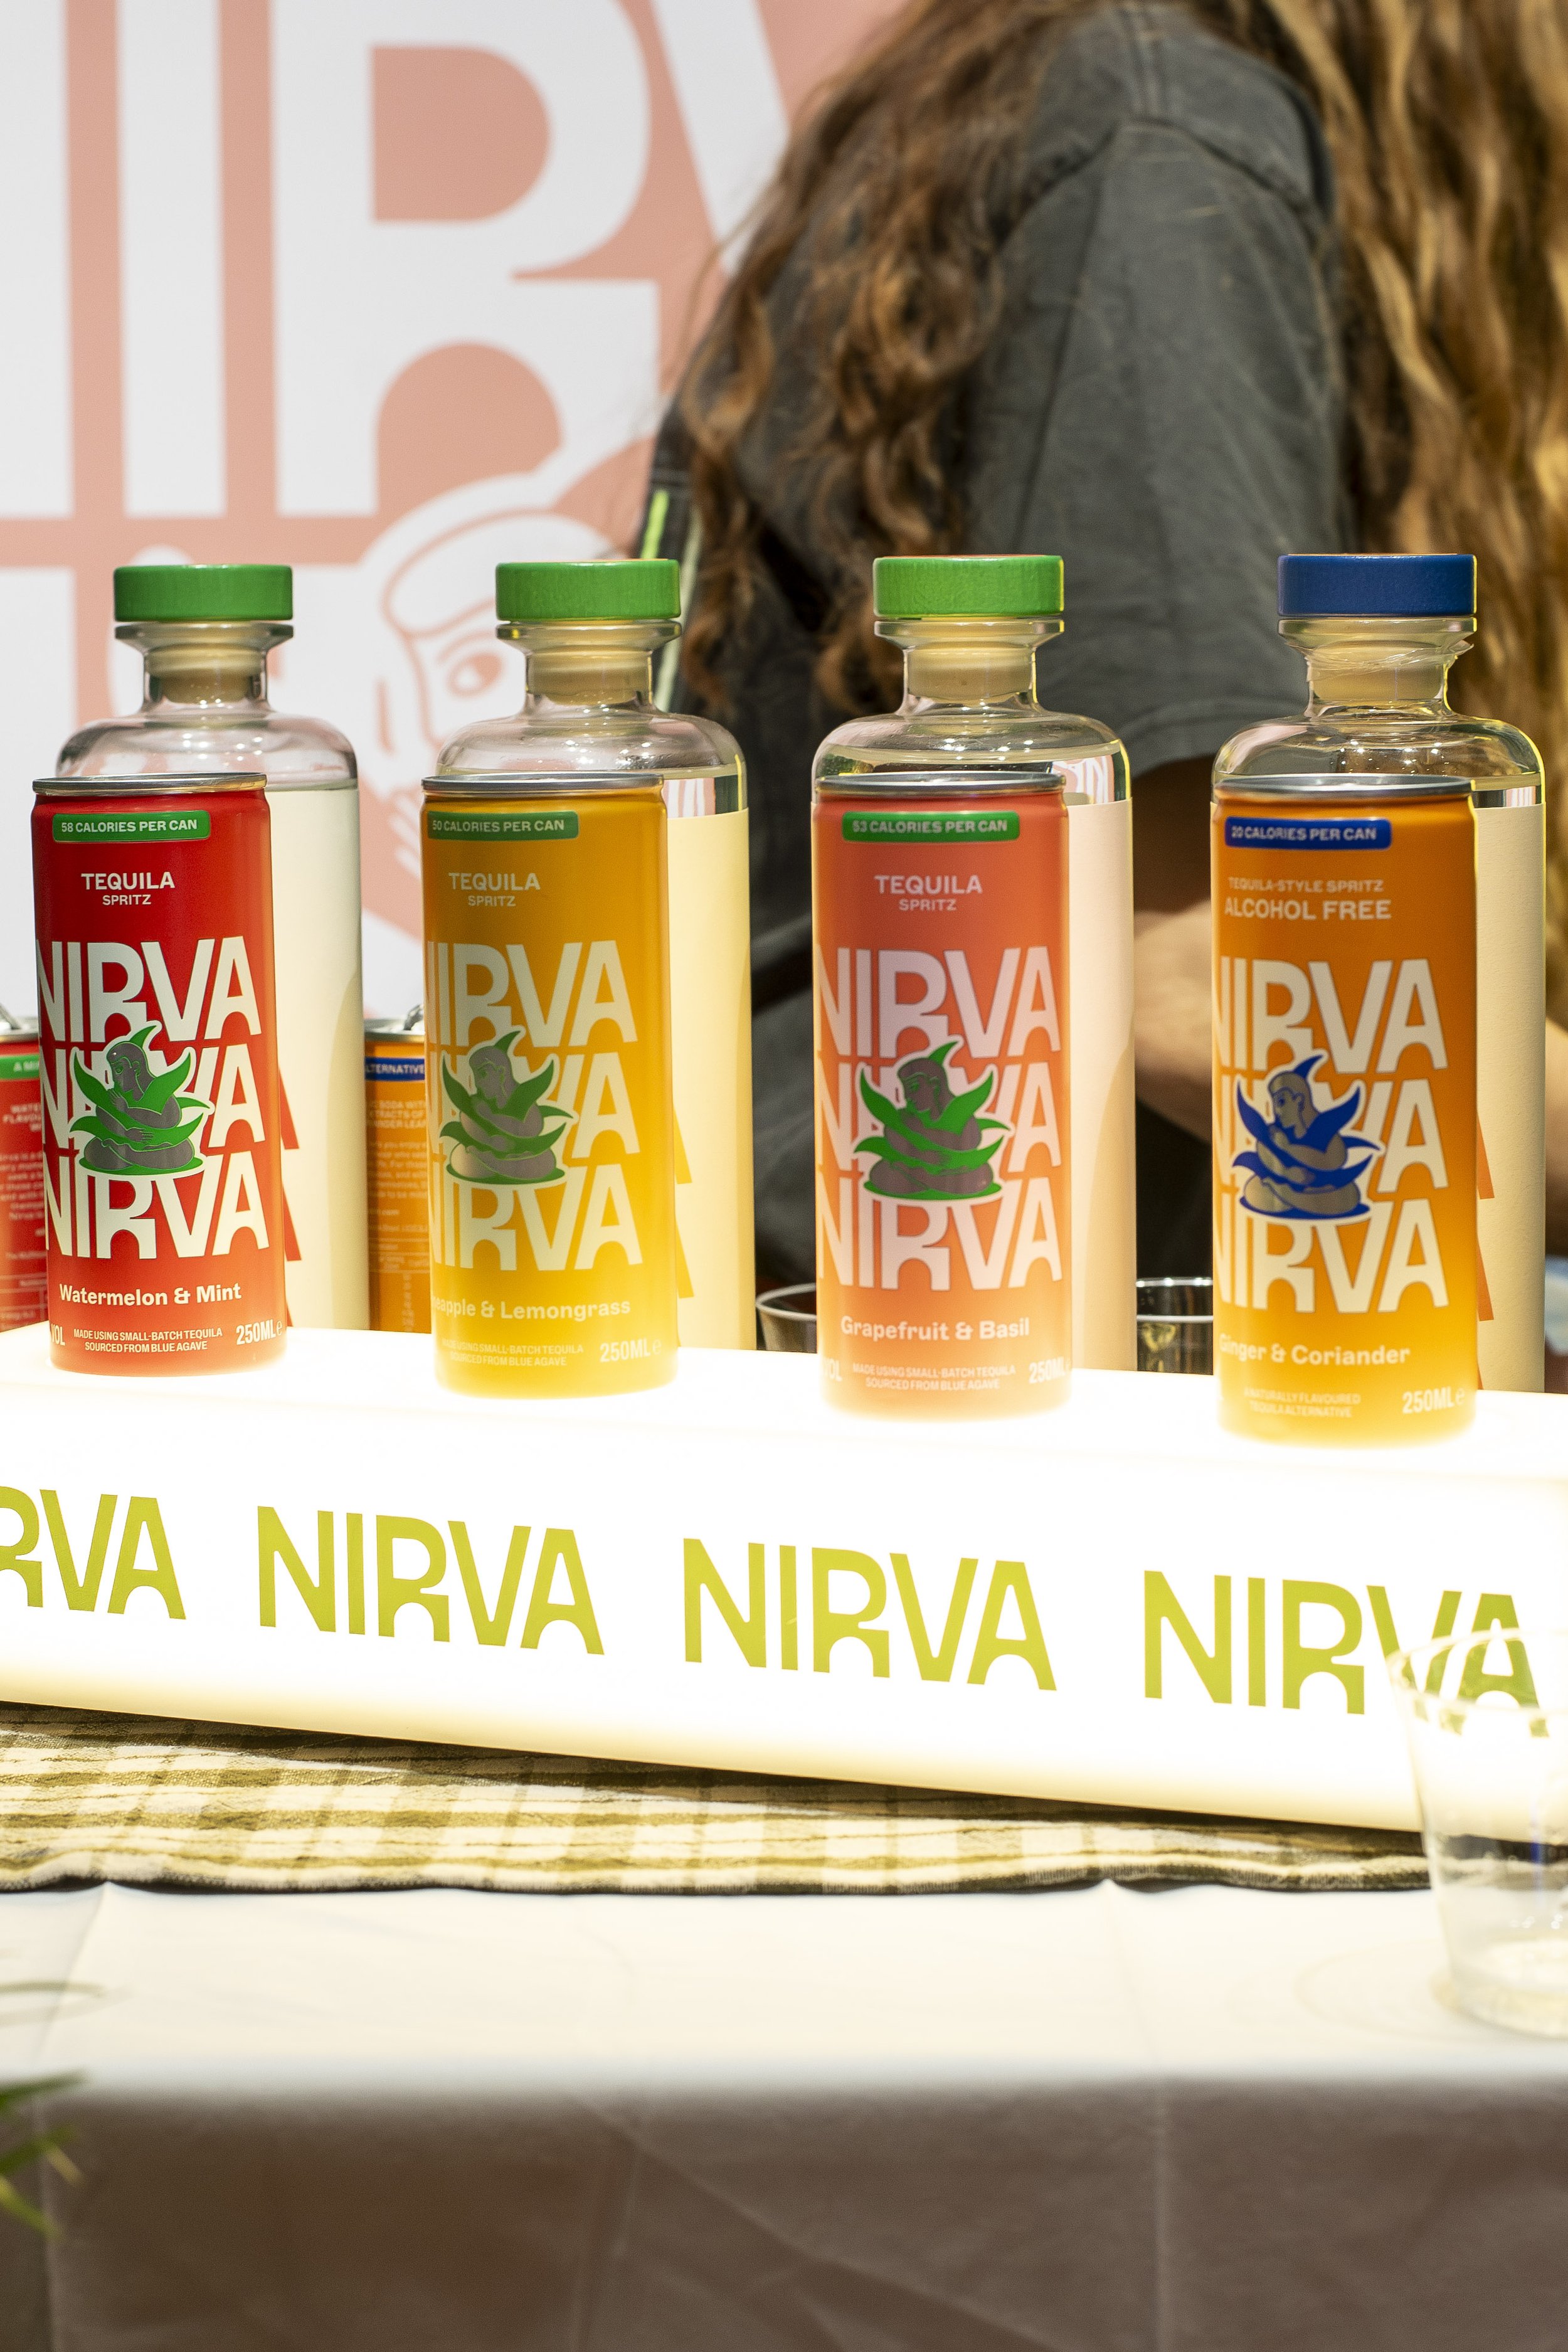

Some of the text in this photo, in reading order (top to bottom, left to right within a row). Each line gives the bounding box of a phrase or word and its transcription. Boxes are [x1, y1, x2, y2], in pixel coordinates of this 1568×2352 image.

[61, 819, 197, 832] 58 CALORIES PER CAN
[443, 820, 501, 832] CALORIES
[503, 821, 531, 832] PER
[534, 819, 564, 831] CAN
[852, 820, 1007, 834] 53 CALORIES PER CAN
[1244, 826, 1306, 841] CALORIES
[1310, 828, 1341, 841] PER
[1343, 827, 1377, 840] CAN
[81, 872, 176, 891] TEQUILA
[448, 872, 541, 891] TEQUILA
[874, 875, 983, 895] TEQUILA
[1228, 876, 1384, 894] TEQUILA-STYLE SPRITZ
[102, 894, 151, 906] SPRITZ
[468, 895, 516, 907] SPRITZ
[899, 899, 956, 911] SPRITZ
[1224, 897, 1392, 921] ALCOHOL FREE
[36, 936, 262, 1044] NIRVA
[816, 945, 1061, 1059] NIRVA
[43, 1150, 270, 1259] NIRVA
[818, 1172, 1062, 1291] NIRVA
[60, 1283, 242, 1306] Watermelon & Mint
[480, 1300, 495, 1317] &
[501, 1300, 630, 1322] Lemongrass
[73, 1327, 223, 1342] MADE USING SMALL-BATCH TEQUILA
[236, 1319, 276, 1345] 250ML
[840, 1315, 1029, 1342] Grapefruit & Basil
[85, 1340, 208, 1353] SOURCED FROM BLUE AGAVE
[458, 1340, 479, 1352] USING
[479, 1343, 541, 1354] SMALL-BATCH
[542, 1344, 584, 1355] TEQUILA
[600, 1339, 650, 1362] 250ML
[1219, 1333, 1411, 1365] Ginger & Coriander
[450, 1352, 567, 1366] SOURCED FROM BLUE AGAVE
[853, 1363, 1016, 1378] MADE USING SMALL-BATCH TEQUILA
[866, 1377, 1000, 1391] SOURCED FROM BLUE AGAVE
[1299, 1392, 1362, 1405] FLAVOURED
[1402, 1386, 1454, 1414] 250ML
[0, 1486, 1549, 1739] RVA NIRVA NIRVA NIRVA
